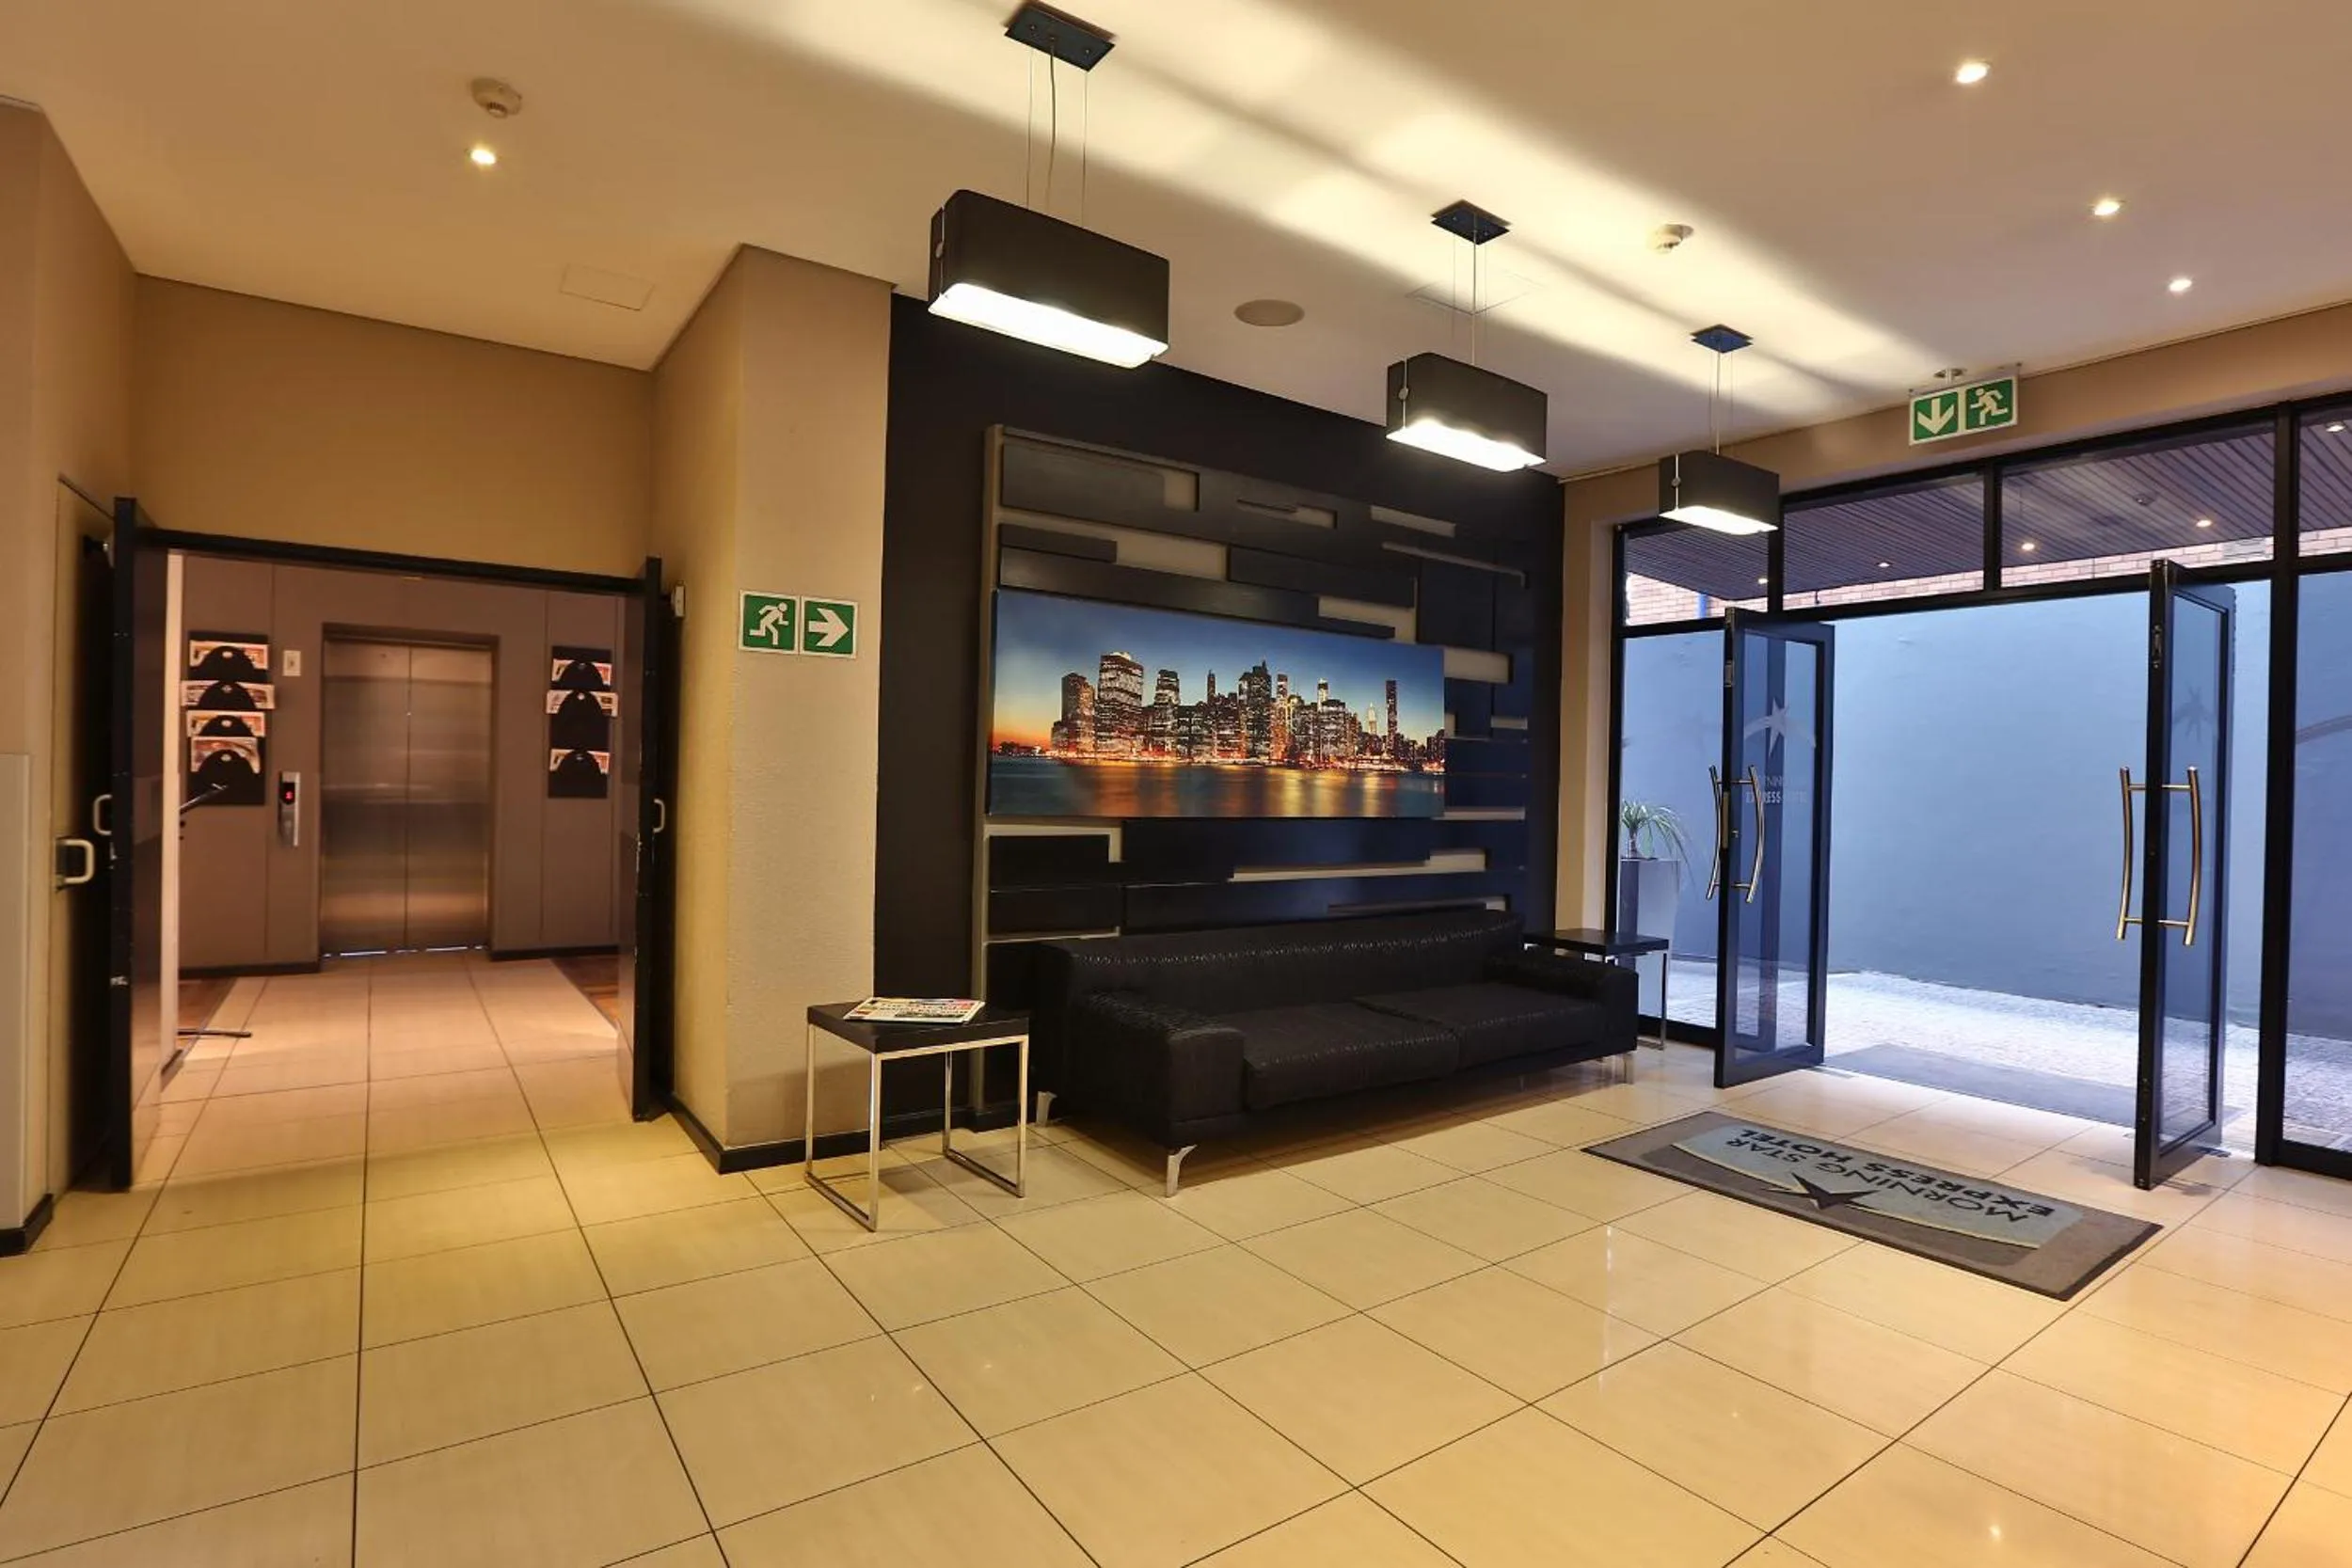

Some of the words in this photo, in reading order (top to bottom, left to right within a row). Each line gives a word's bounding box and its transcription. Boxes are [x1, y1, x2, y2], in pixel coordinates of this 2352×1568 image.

[1725, 1138, 1807, 1163] STAR
[1740, 1129, 1852, 1163] HOTEL
[1815, 1163, 2028, 1222] MORNING
[1863, 1162, 2055, 1216] EXPRESS
